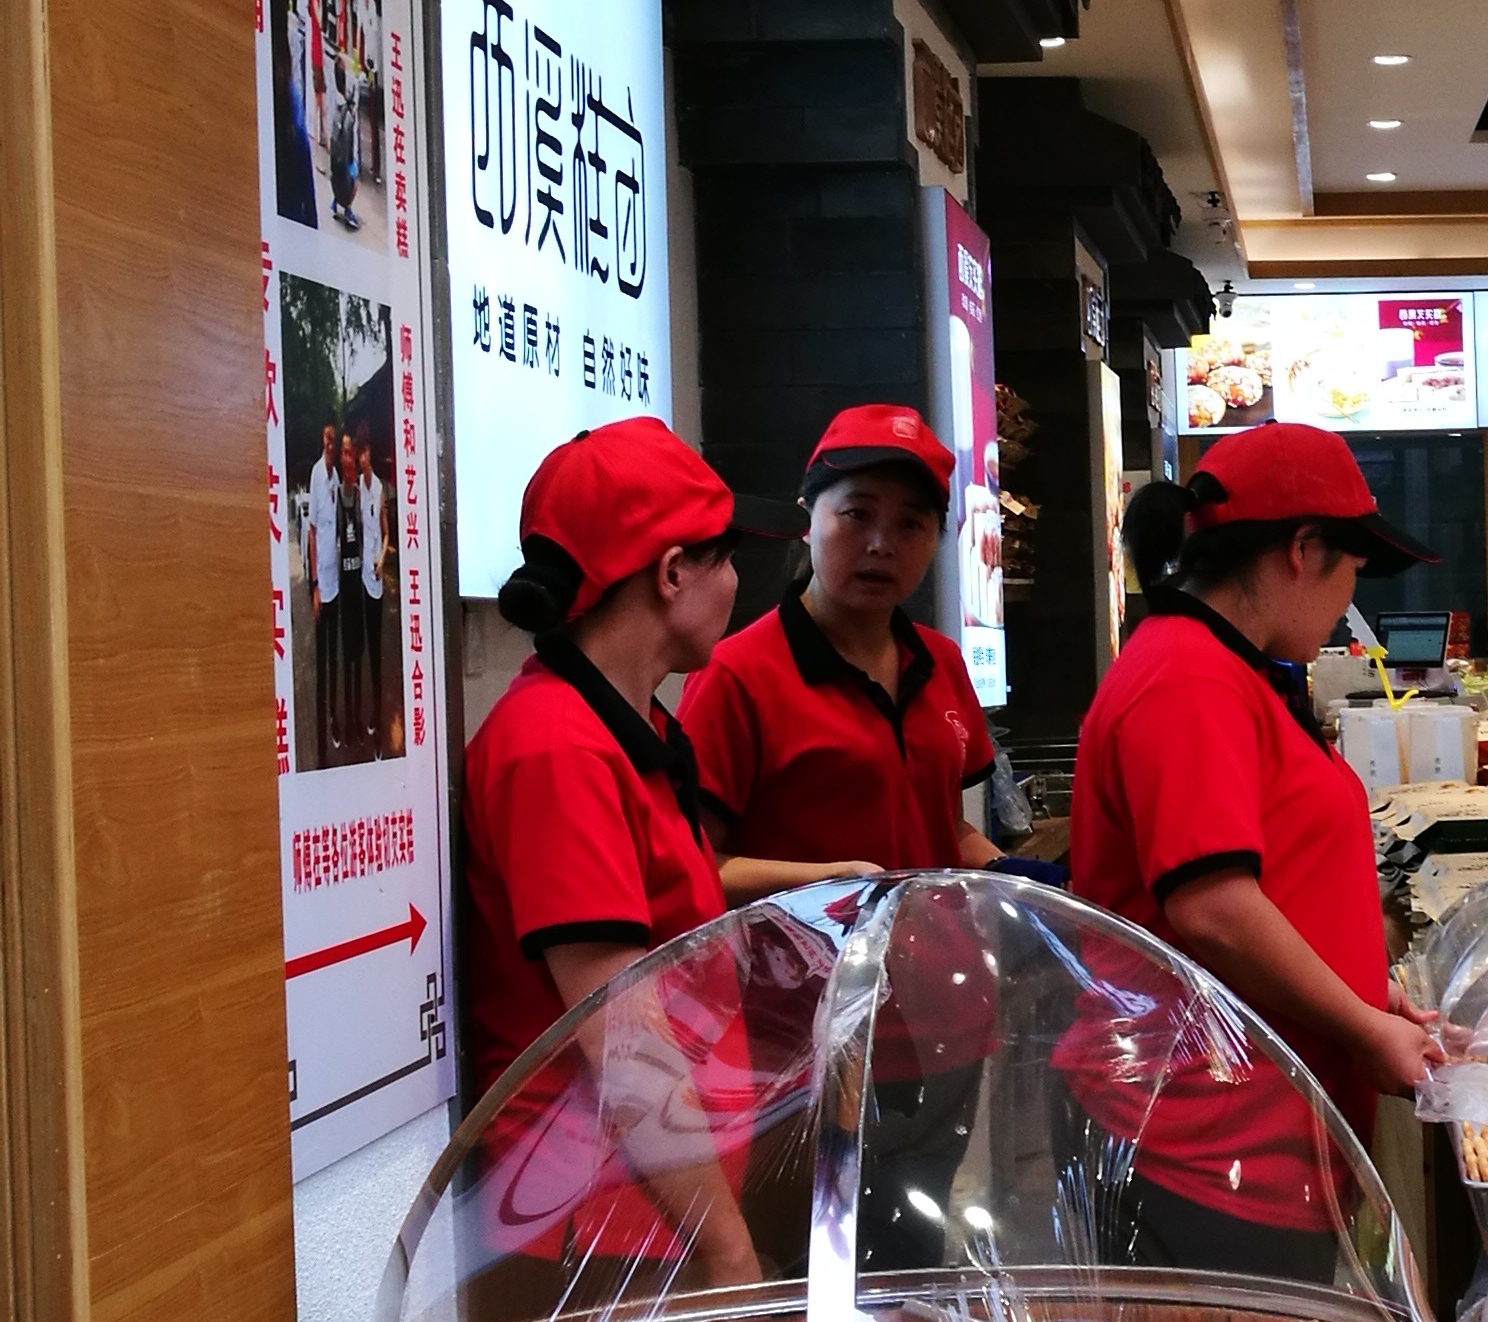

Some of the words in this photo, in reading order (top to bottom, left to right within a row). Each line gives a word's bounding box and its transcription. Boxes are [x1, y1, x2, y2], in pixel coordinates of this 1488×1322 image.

[472, 284, 561, 378] 地道原材
[582, 329, 651, 407] 自然好味
[399, 324, 418, 550] 师傅和艺兴
[408, 566, 426, 747] 王迅合影
